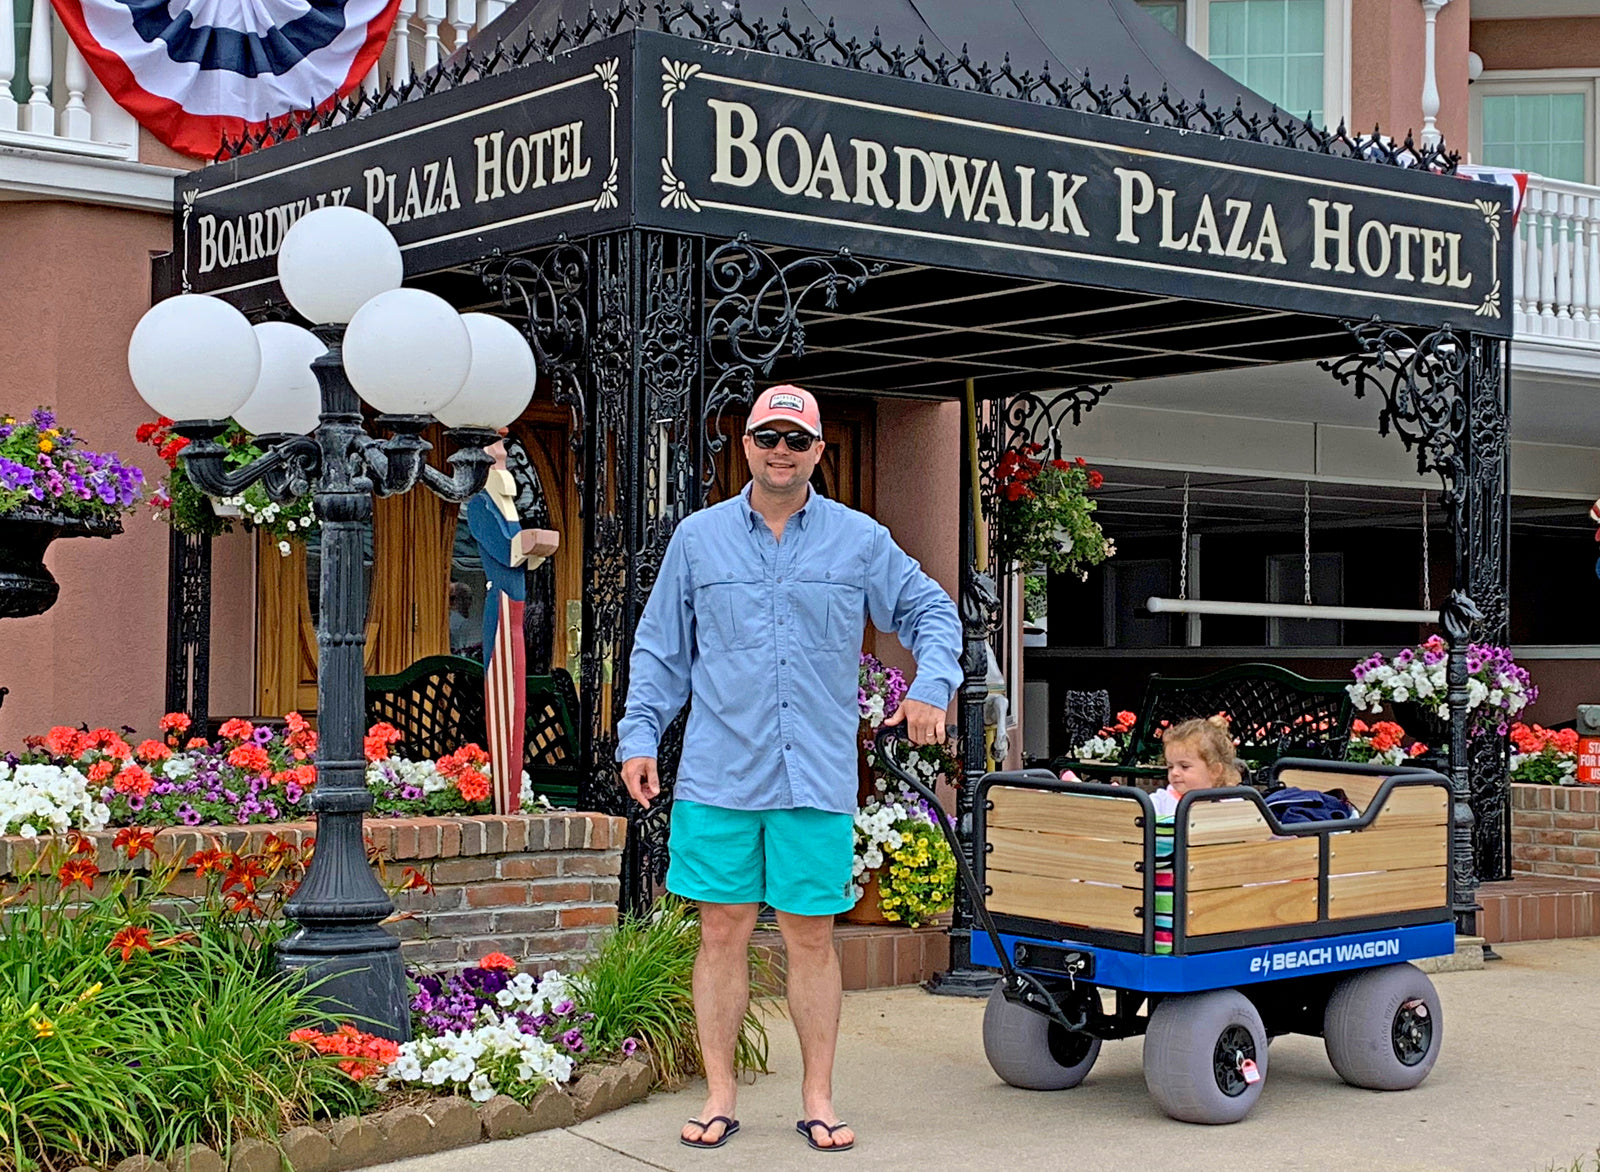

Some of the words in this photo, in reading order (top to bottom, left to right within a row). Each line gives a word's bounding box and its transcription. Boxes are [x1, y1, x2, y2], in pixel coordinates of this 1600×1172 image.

[363, 156, 461, 226] PLAZA
[474, 120, 592, 204] HOTEL
[707, 99, 1090, 237] BOARDWALK
[1114, 168, 1287, 265] PLAZA
[1309, 198, 1472, 289] HOTEL
[1580, 754, 1597, 767] FOR
[1272, 947, 1332, 971] BEACH
[1336, 938, 1400, 962] WAGON
